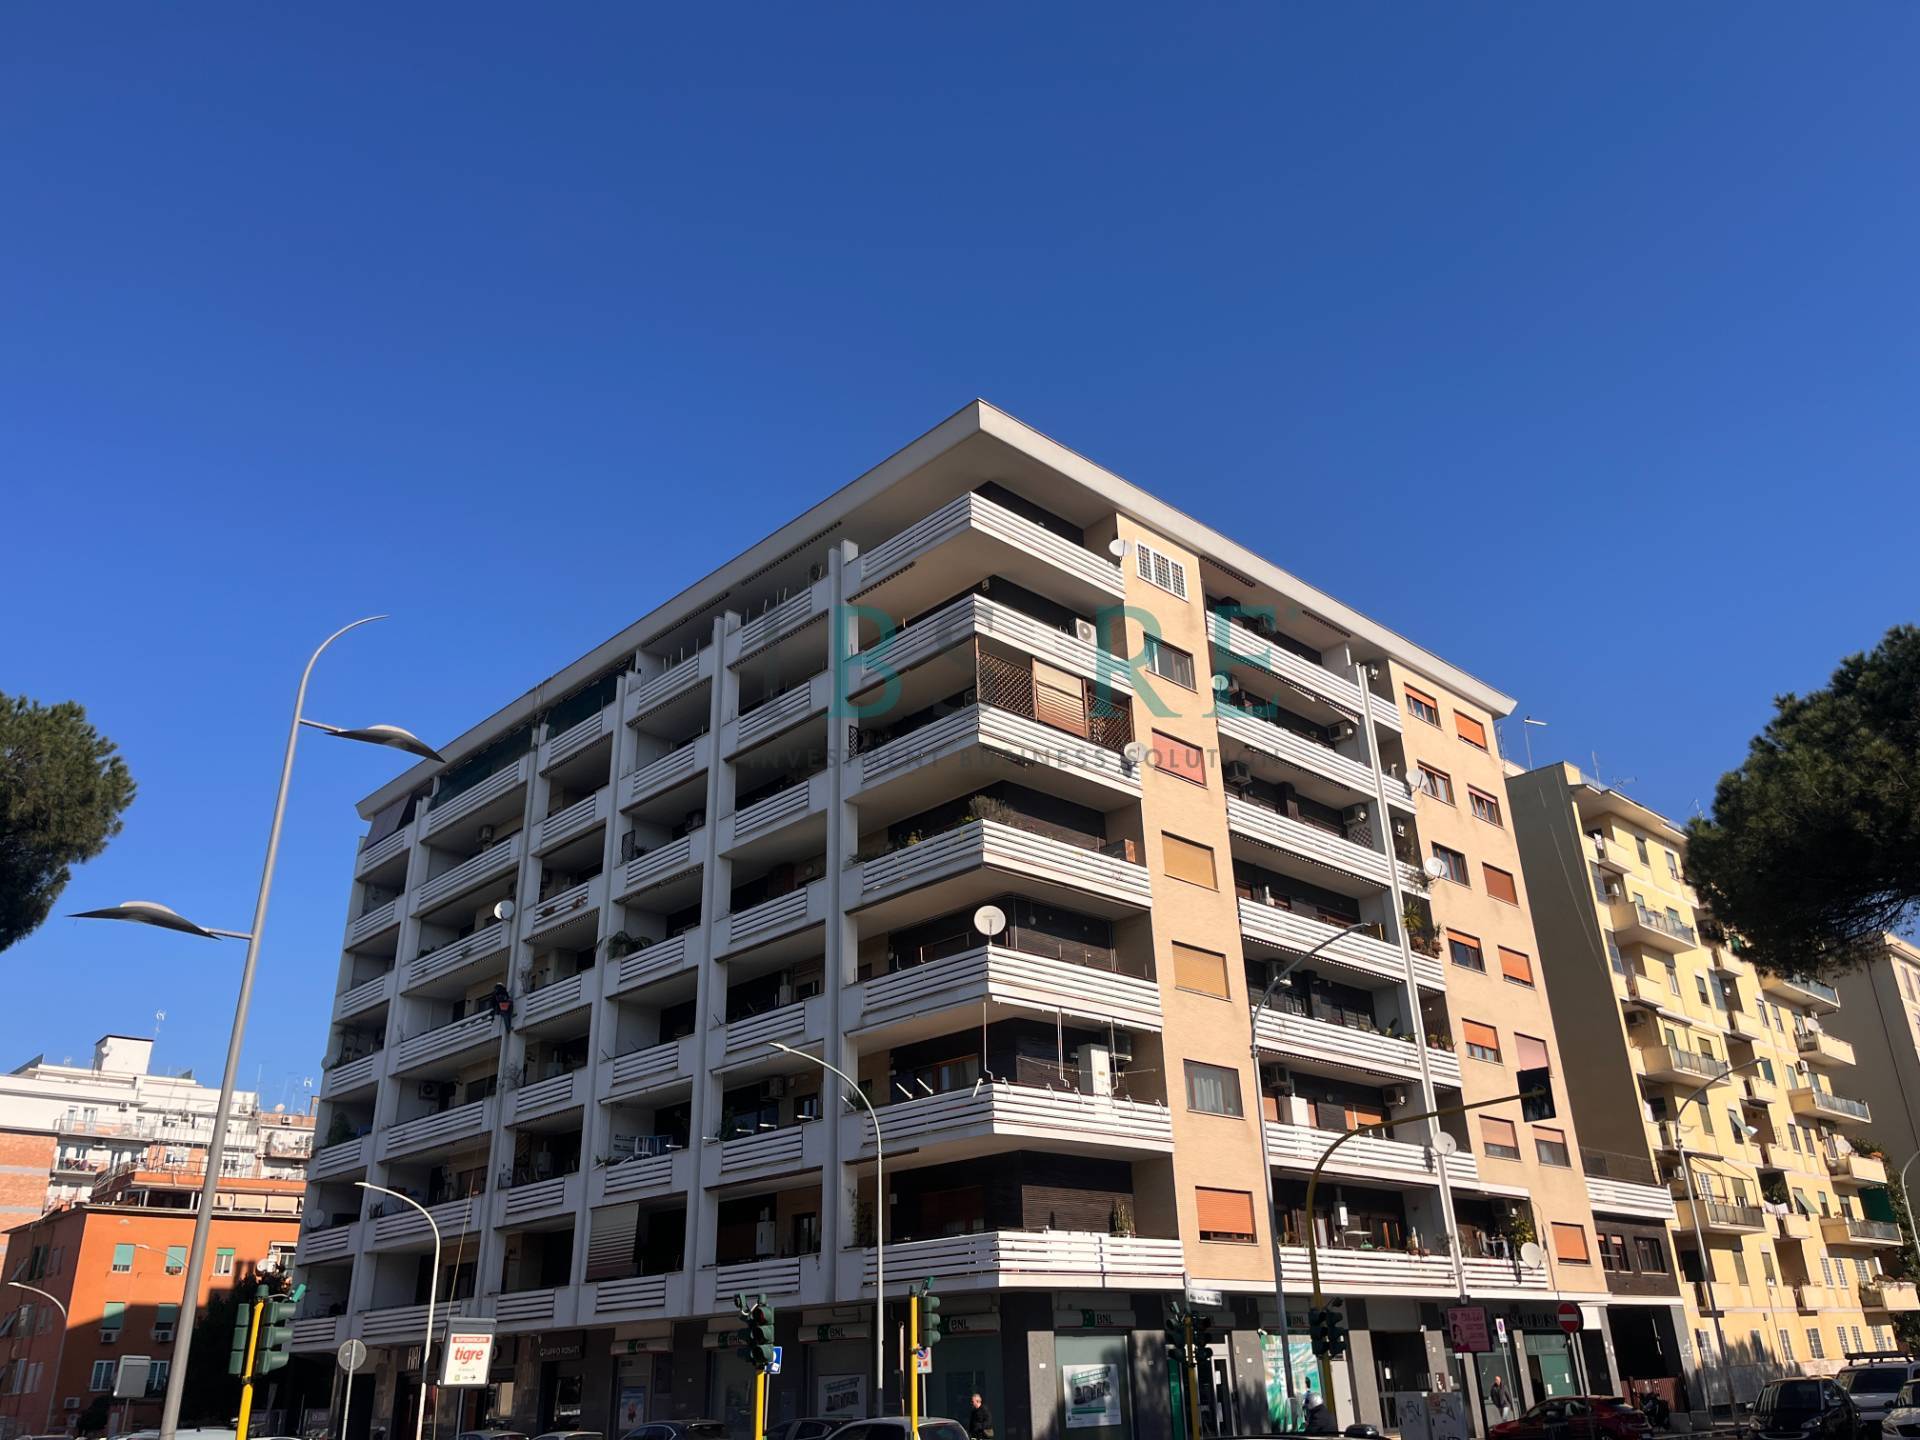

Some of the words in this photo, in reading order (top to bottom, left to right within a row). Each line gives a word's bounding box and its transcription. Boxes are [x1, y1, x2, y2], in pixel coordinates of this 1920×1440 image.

[951, 1318, 970, 1329] BNL
[1096, 1313, 1113, 1325] BNL
[830, 1327, 845, 1337] BNL
[455, 1346, 483, 1365] tigre
